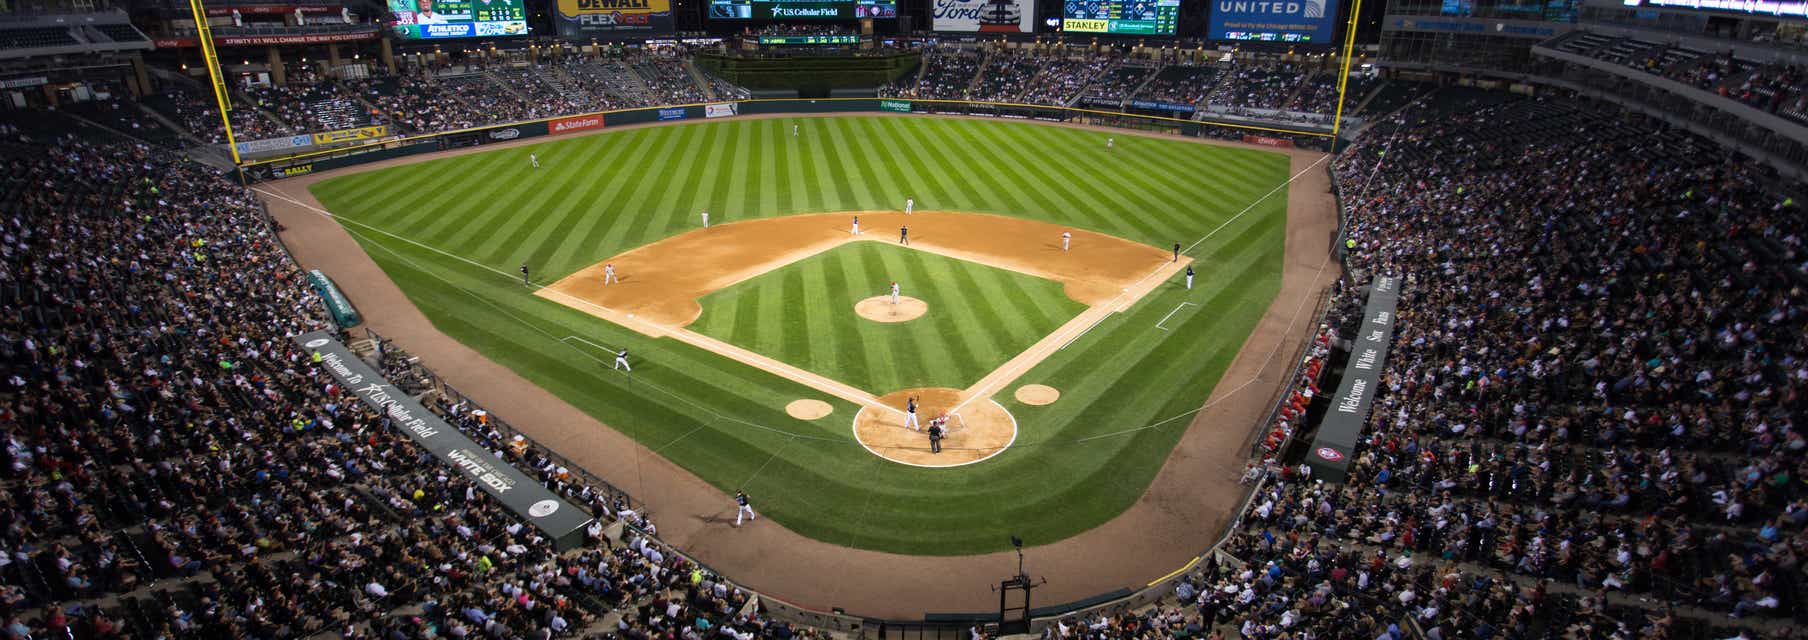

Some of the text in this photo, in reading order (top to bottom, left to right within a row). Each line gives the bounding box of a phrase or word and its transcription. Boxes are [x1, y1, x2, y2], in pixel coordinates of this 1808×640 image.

[821, 8, 838, 16] Field
[932, 0, 986, 20] Ford
[1220, 1, 1300, 14] UNITED
[1065, 21, 1106, 30] STANLEY
[285, 164, 313, 176] RALLY
[1365, 329, 1384, 343] Sox
[1354, 348, 1377, 370] White
[1338, 378, 1367, 414] Welcome
[405, 418, 439, 438] Field
[447, 449, 487, 476] WHITE
[480, 472, 513, 493] SOX
